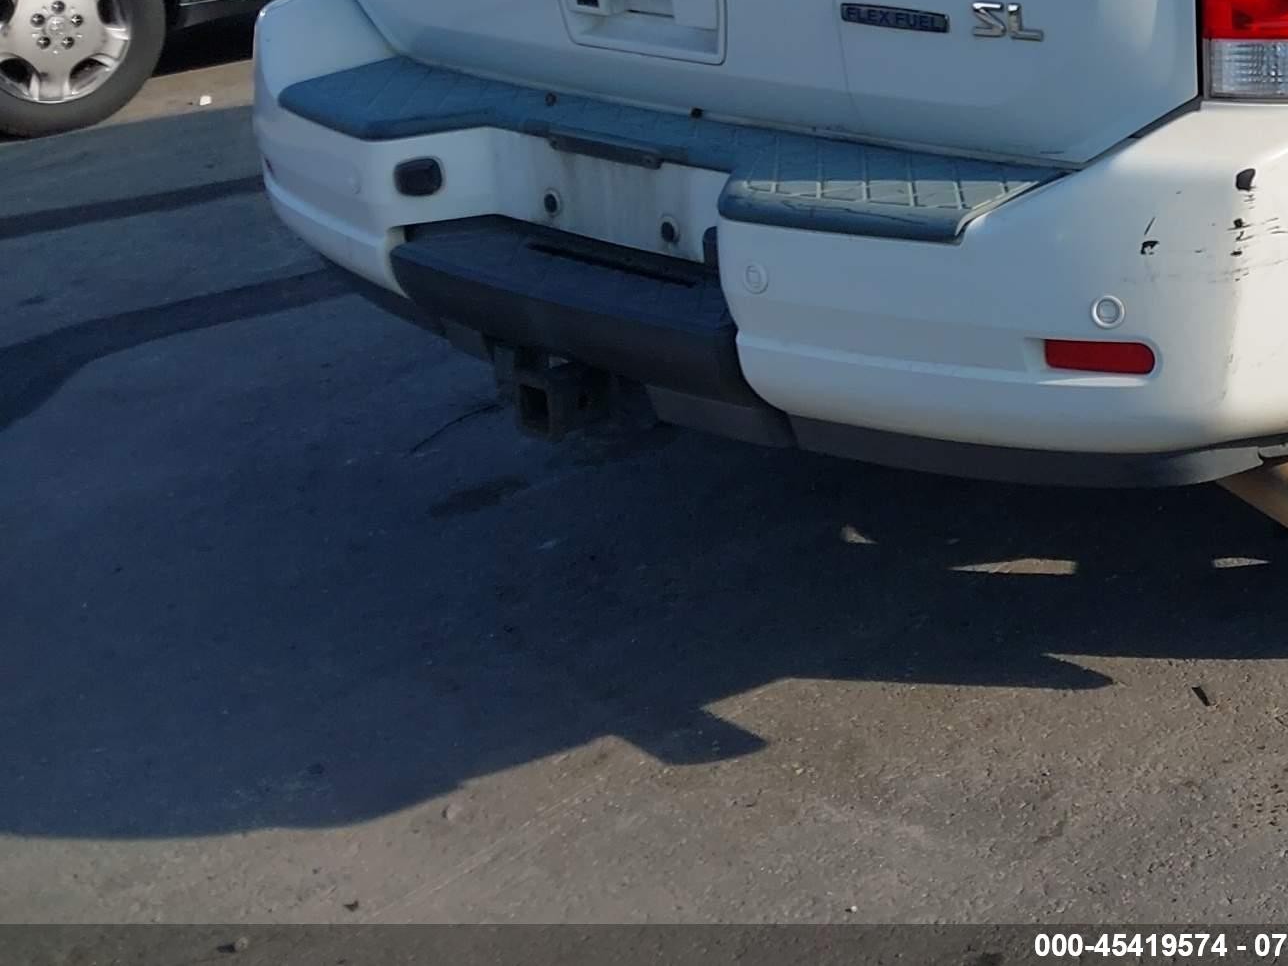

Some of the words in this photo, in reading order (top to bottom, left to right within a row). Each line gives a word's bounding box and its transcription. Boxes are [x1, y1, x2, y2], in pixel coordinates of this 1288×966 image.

[844, 6, 894, 25] FLEX
[895, 11, 943, 30] FUEL
[971, 0, 1044, 42] SL
